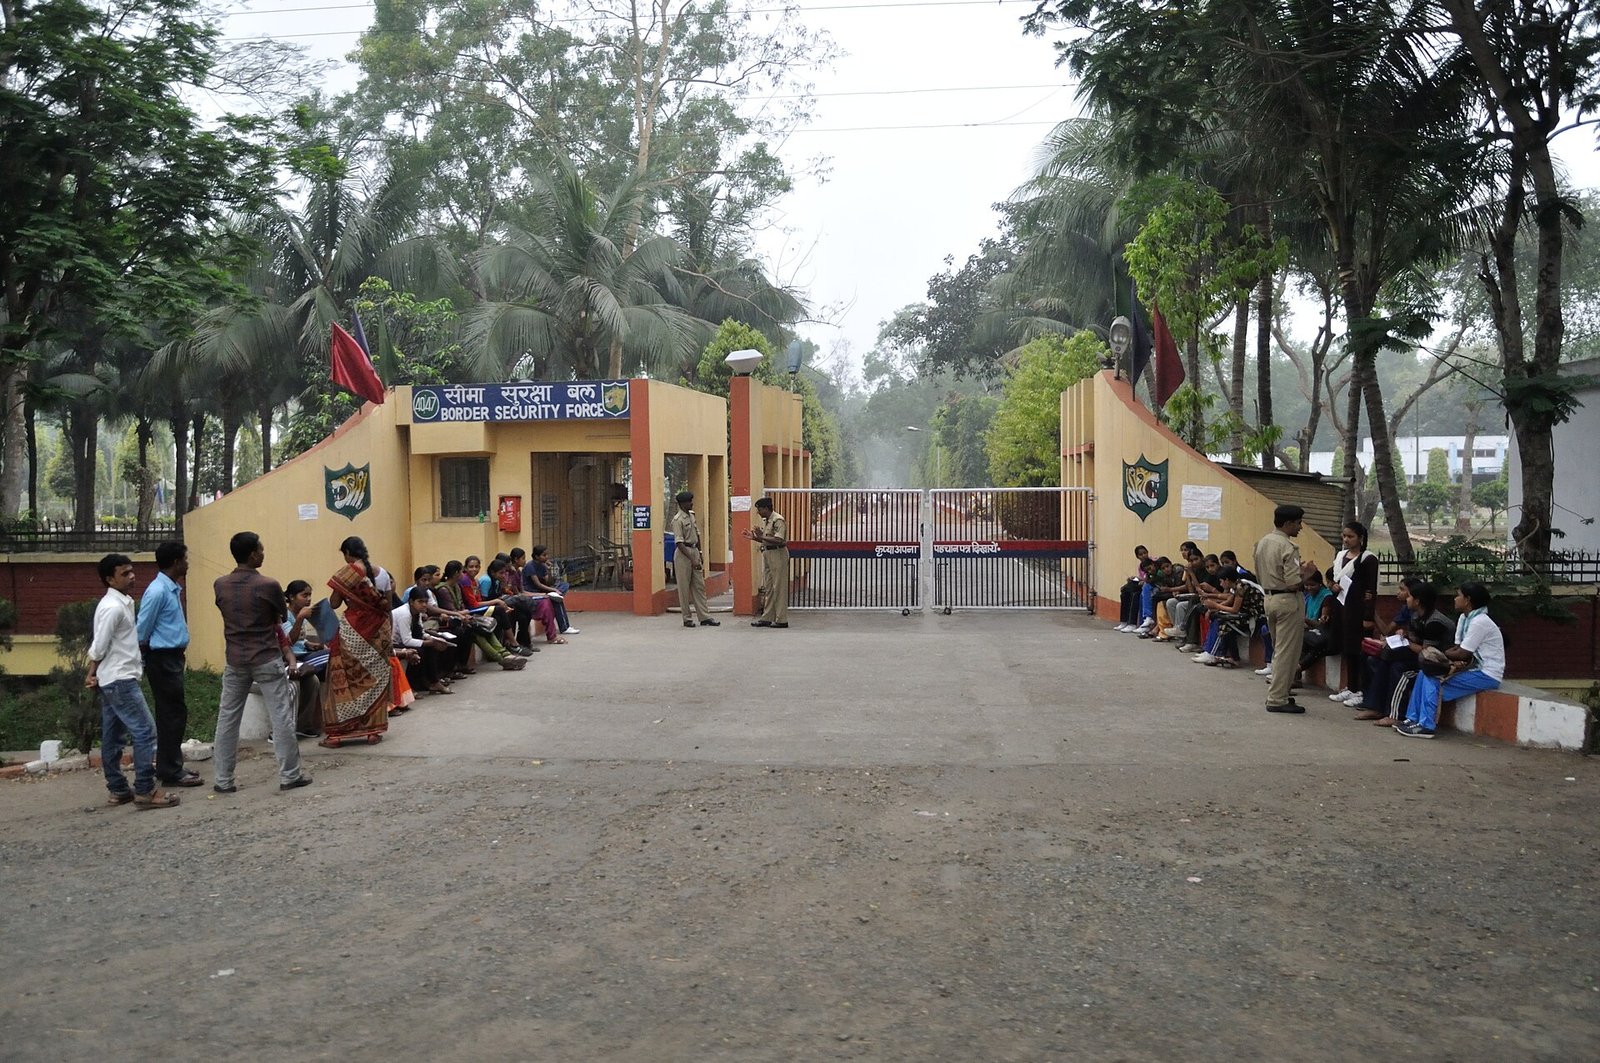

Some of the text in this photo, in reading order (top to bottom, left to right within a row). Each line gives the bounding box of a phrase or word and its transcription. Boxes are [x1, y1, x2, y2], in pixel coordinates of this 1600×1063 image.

[443, 384, 597, 407] सीमा सुरक्षा बल
[441, 402, 604, 421] BORDER SECURITY FORCE
